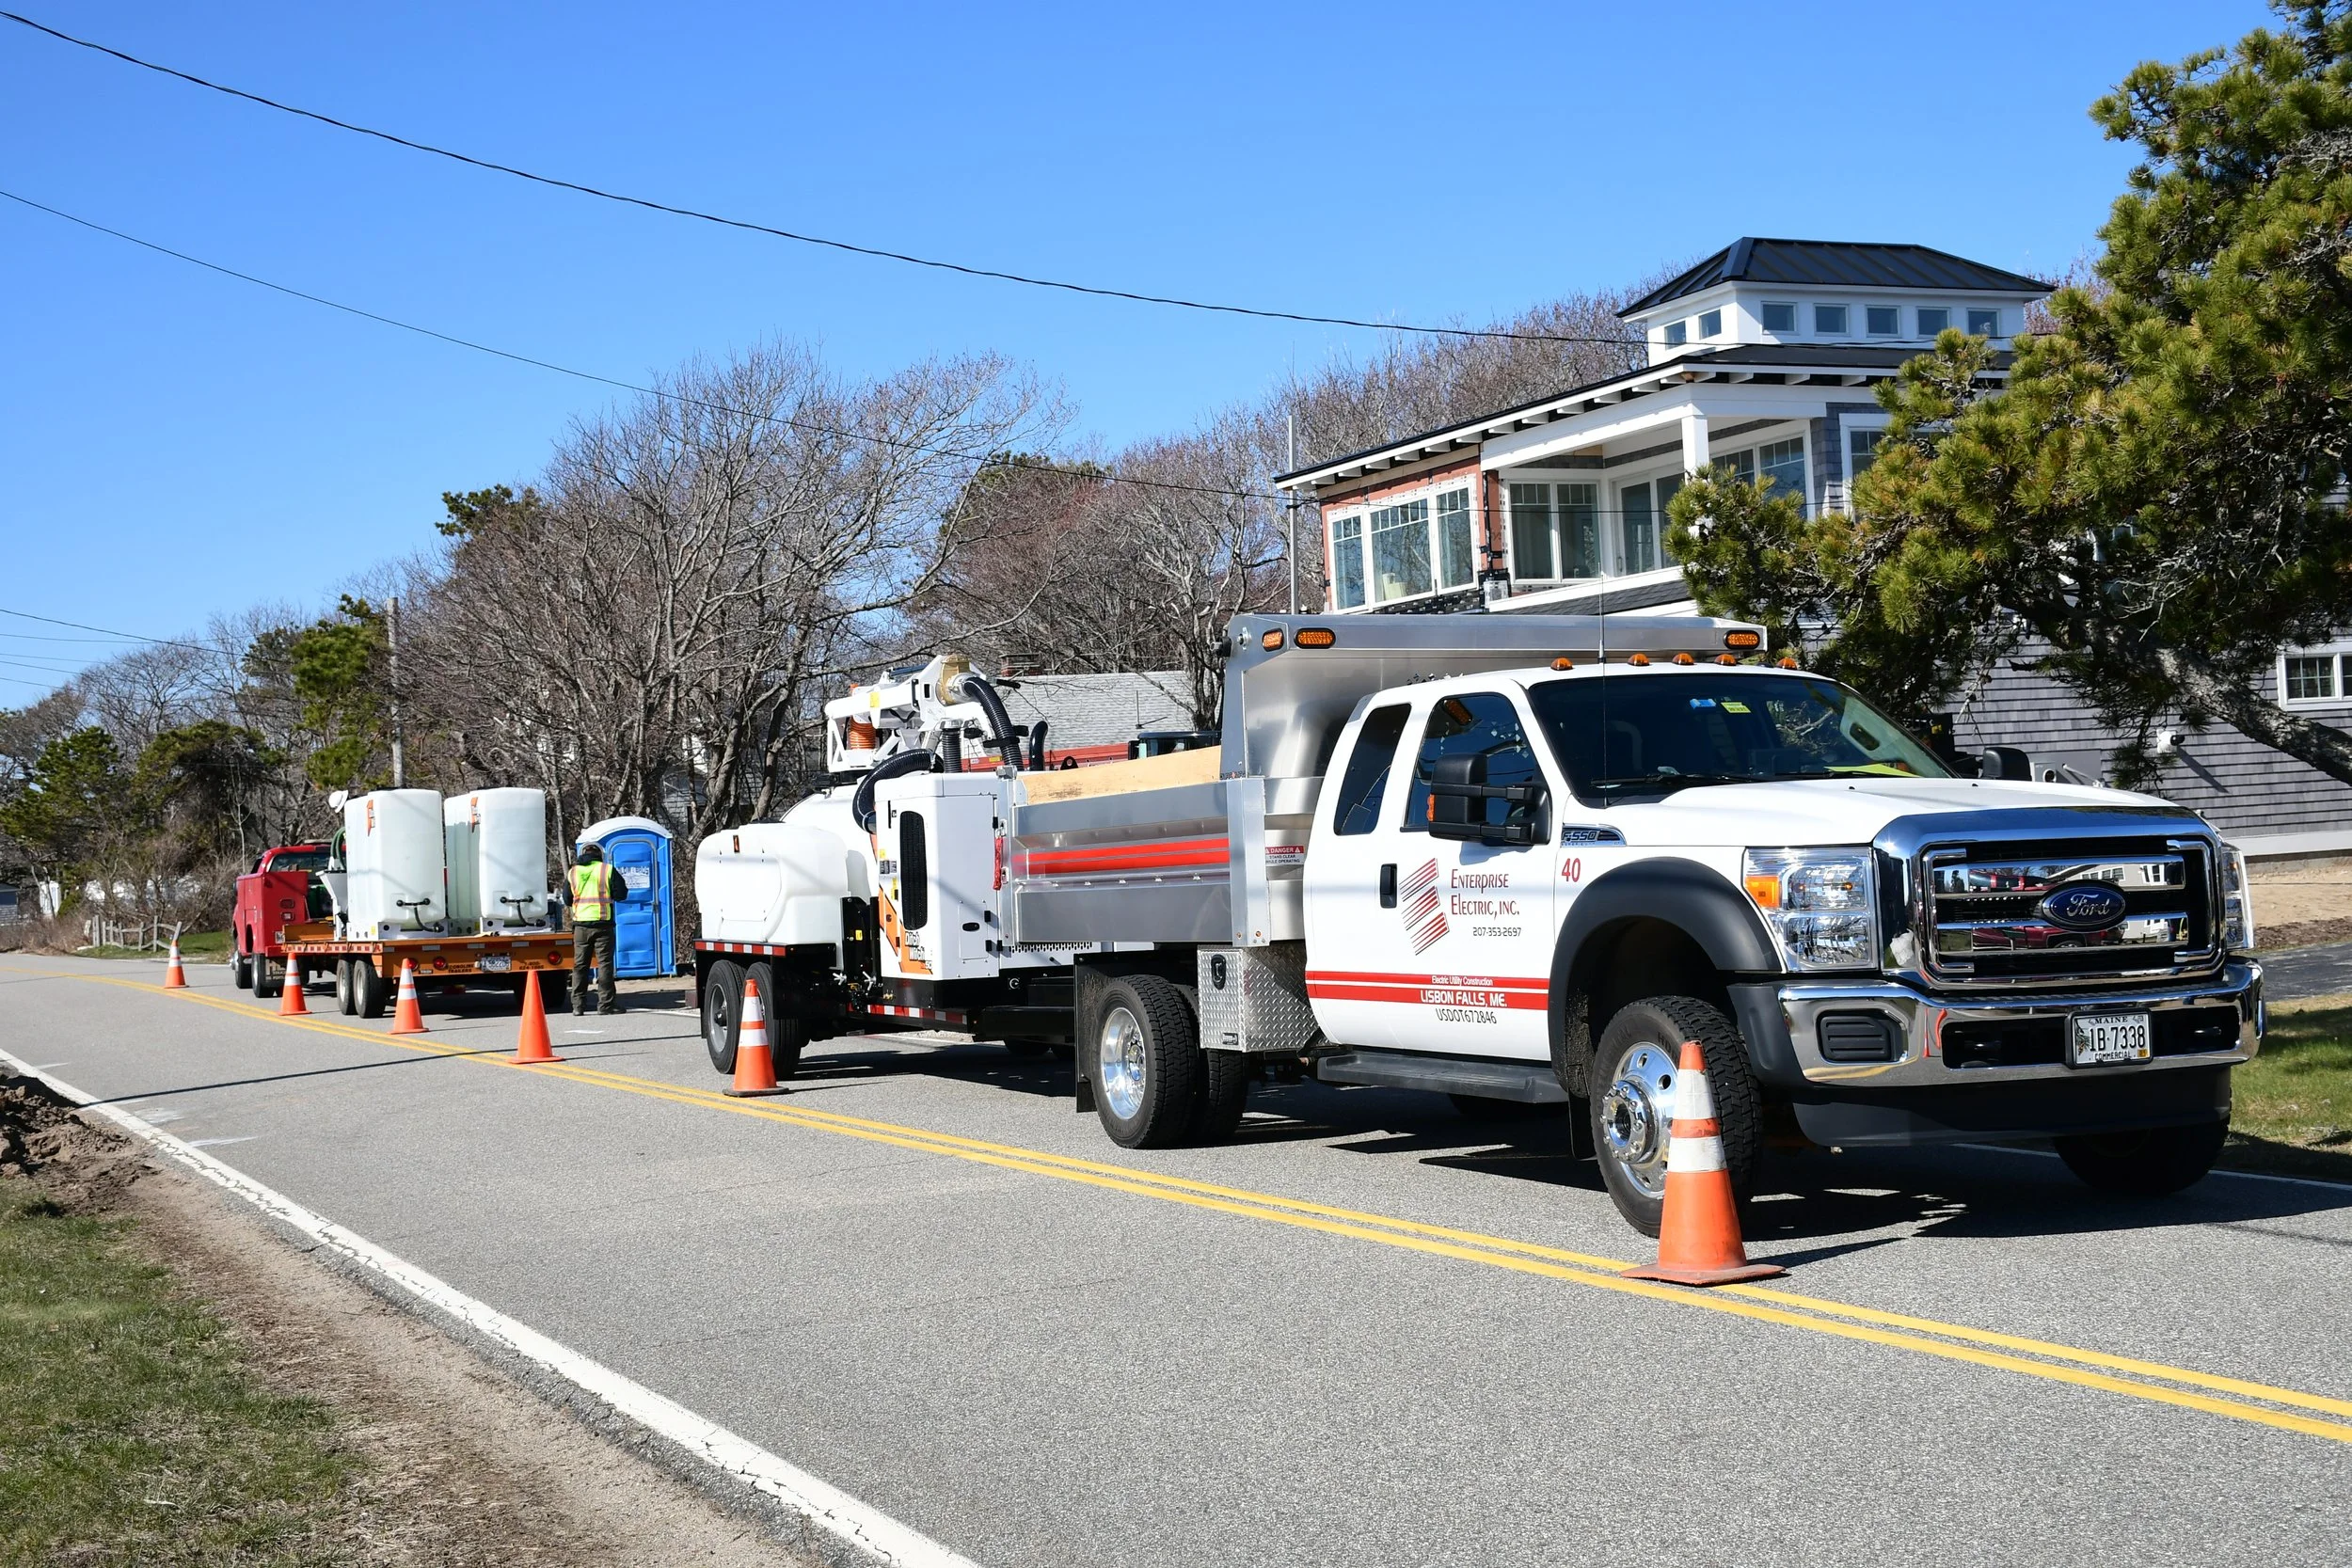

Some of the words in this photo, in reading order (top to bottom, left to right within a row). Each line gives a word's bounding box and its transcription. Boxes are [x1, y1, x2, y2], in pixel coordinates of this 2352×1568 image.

[1561, 858, 1581, 882] 40
[1499, 900, 1520, 915] INC.
[2066, 894, 2110, 917] Ford
[1472, 927, 1522, 937] 207-353-2697
[1431, 974, 1450, 985] Electric
[1449, 975, 1462, 987] Utility
[1463, 976, 1494, 986] Construction
[1420, 990, 1454, 1005] LISBON
[1455, 990, 1488, 1008] FALLS,
[1489, 992, 1508, 1007] ME.
[1435, 1007, 1498, 1024] USDOT672846
[2094, 1016, 2128, 1024] MAINE
[2094, 1050, 2132, 1061] COMMERCIAL
